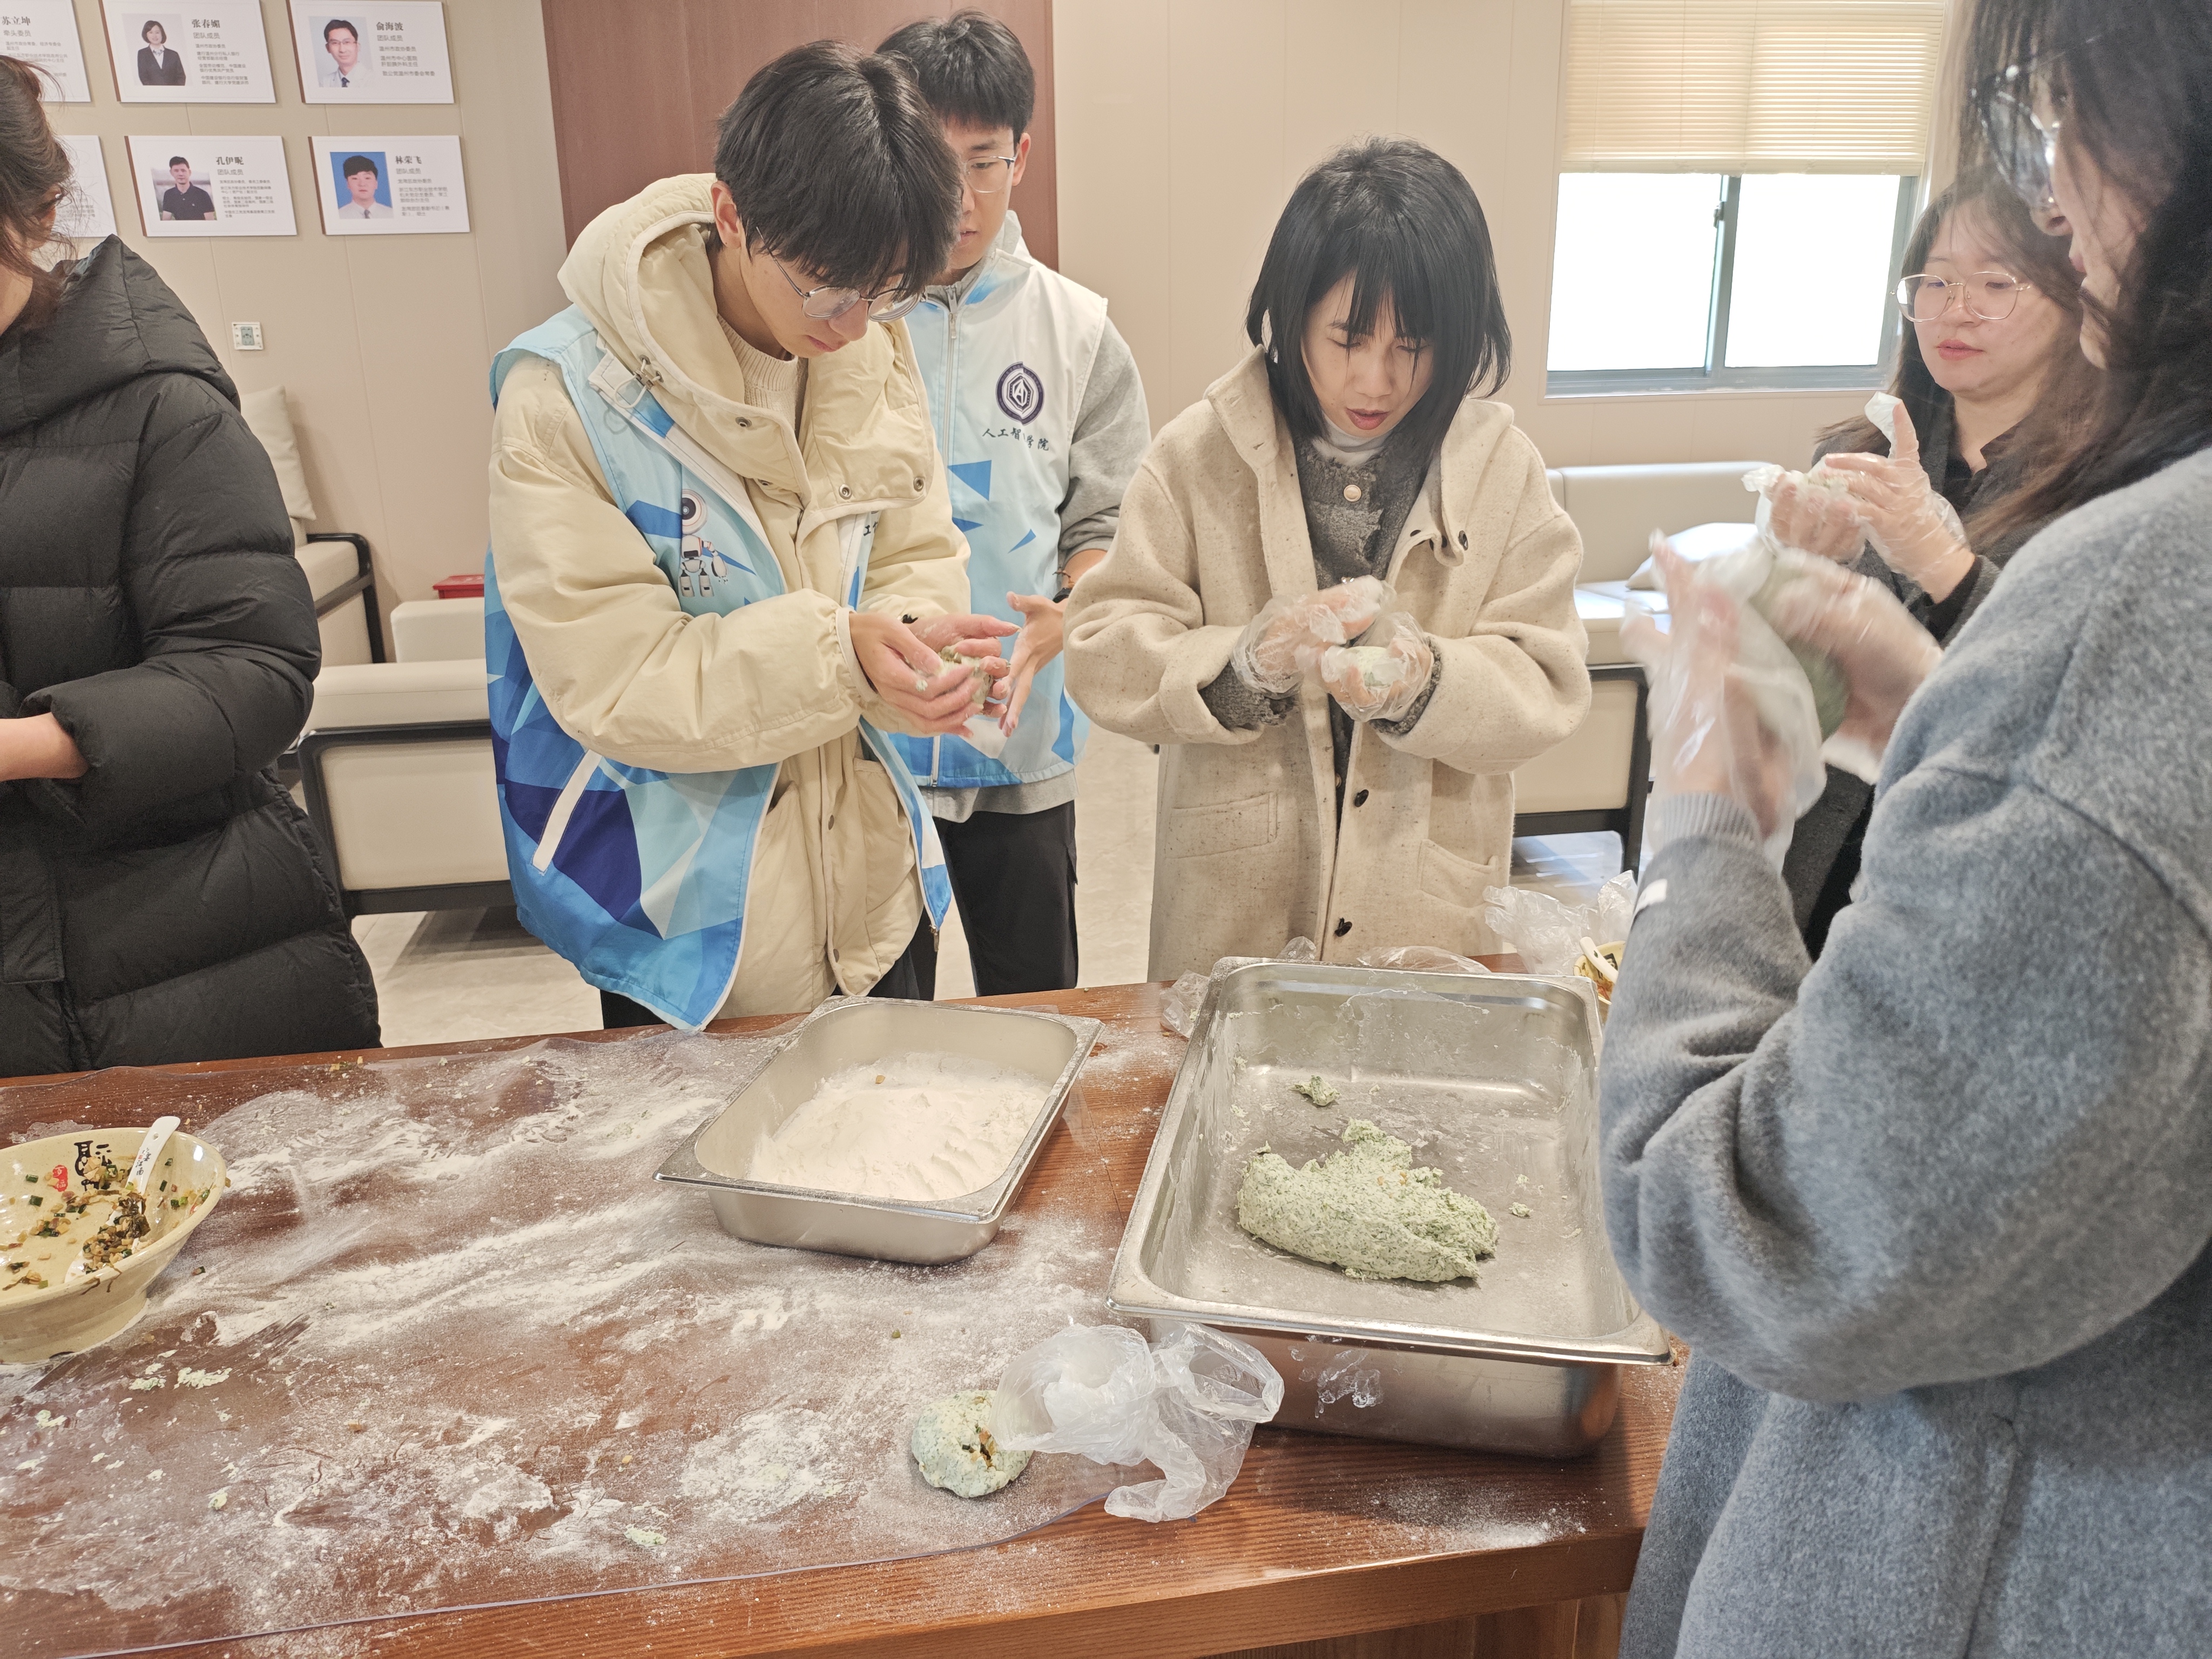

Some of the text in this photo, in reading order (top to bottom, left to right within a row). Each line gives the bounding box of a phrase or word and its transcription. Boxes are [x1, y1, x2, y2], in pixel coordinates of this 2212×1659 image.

[2, 16, 31, 25] 苏立坤
[376, 22, 403, 31] 俞海波
